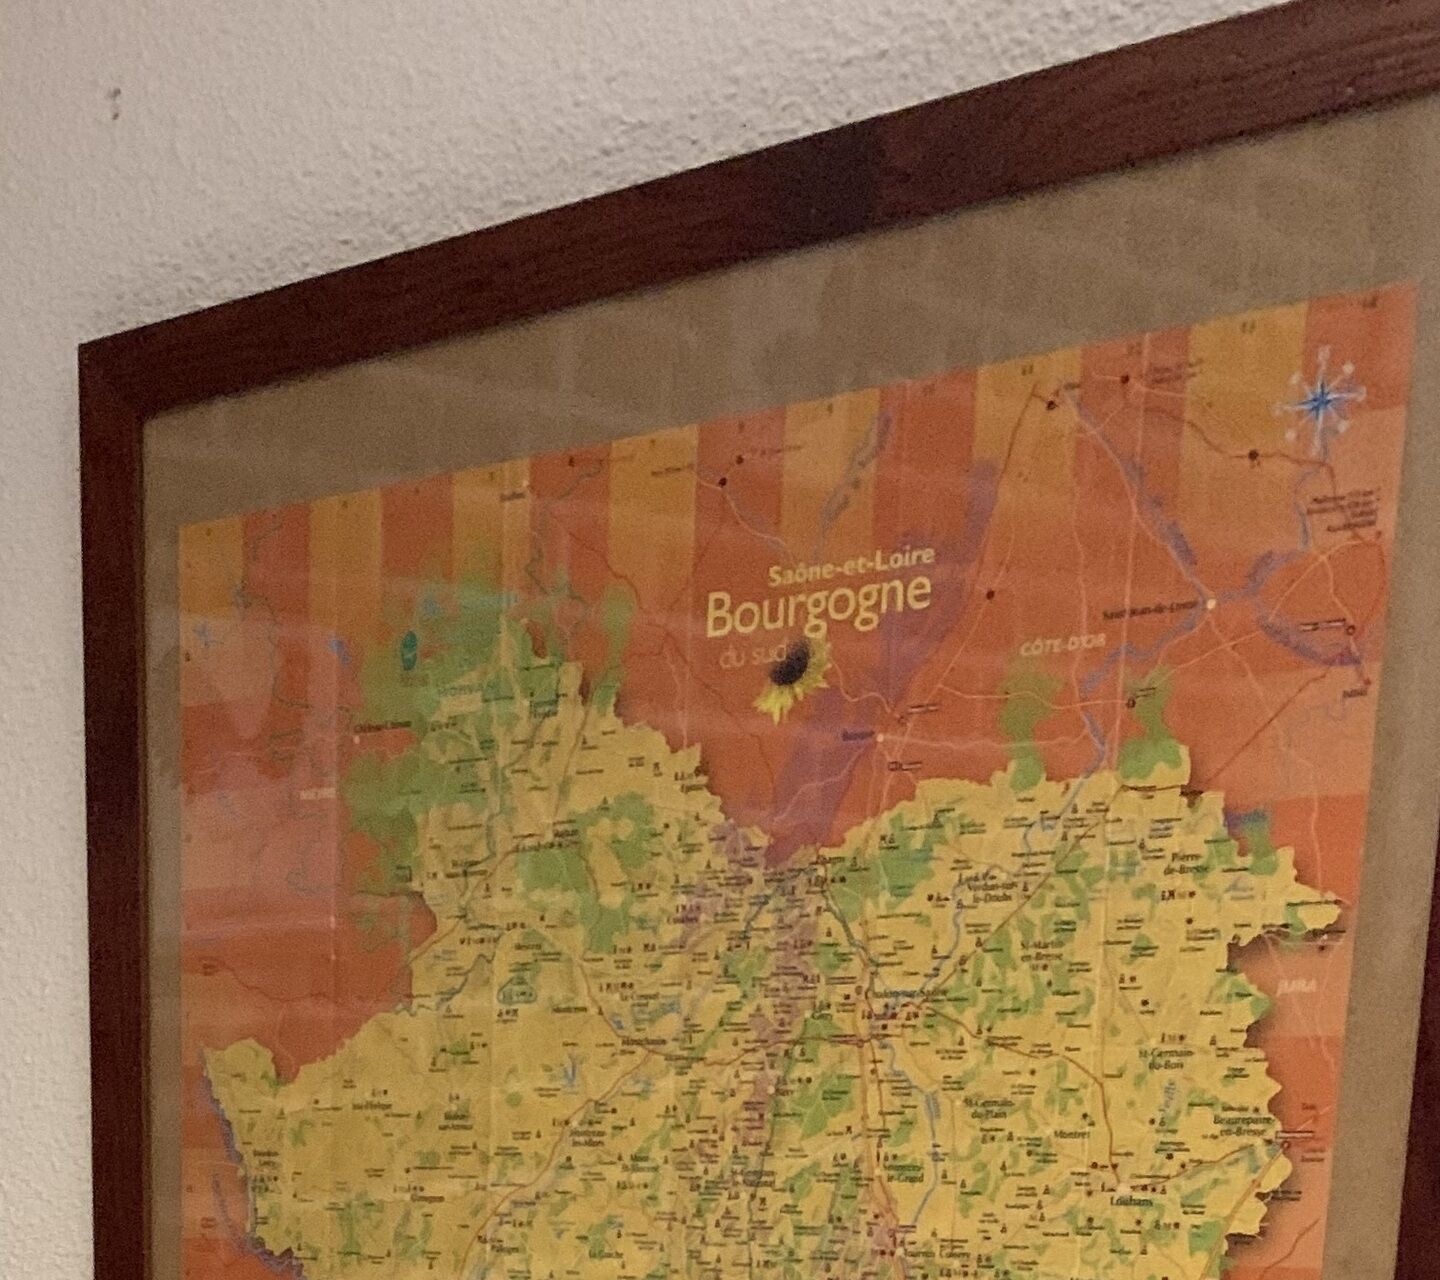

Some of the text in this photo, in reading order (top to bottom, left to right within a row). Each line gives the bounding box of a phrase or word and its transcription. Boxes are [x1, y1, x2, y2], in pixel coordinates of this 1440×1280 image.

[768, 545, 936, 588] Saône-et-Loire
[706, 575, 932, 639] Bourgogne
[719, 645, 745, 669] du
